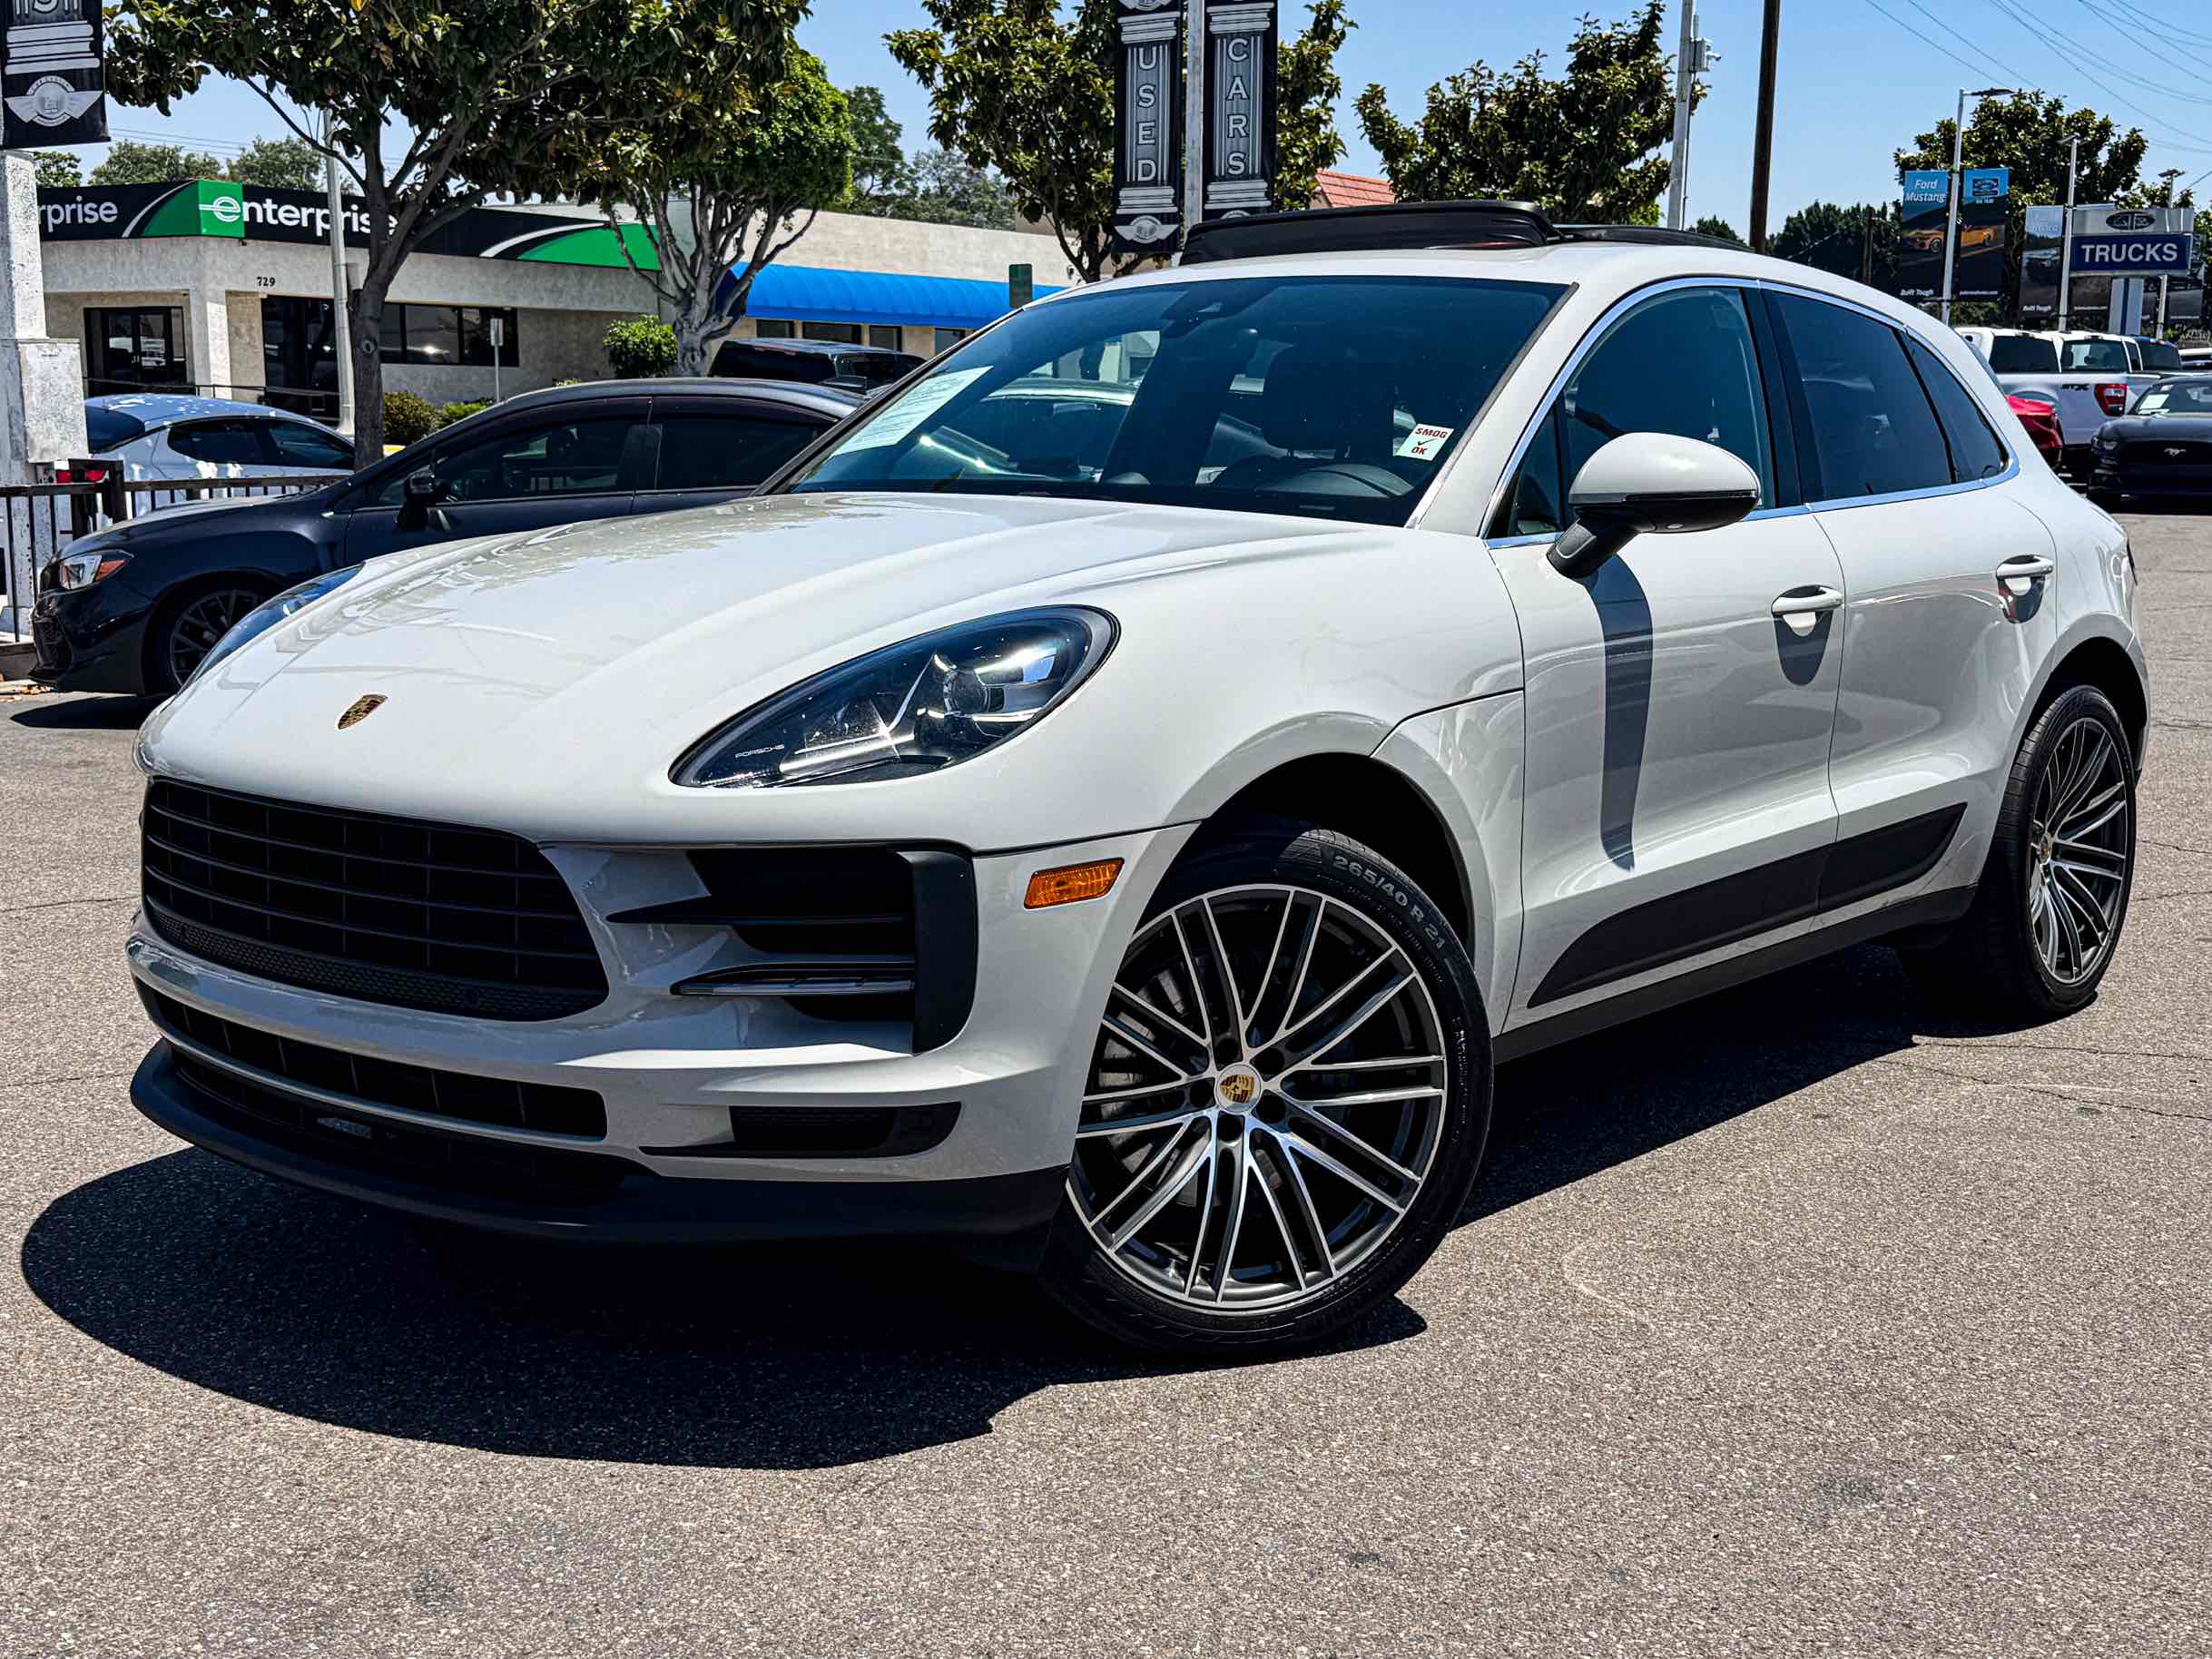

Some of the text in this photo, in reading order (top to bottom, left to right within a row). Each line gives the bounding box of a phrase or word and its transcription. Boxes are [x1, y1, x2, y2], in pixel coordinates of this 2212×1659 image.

[1226, 38, 1250, 175] CARS
[1137, 46, 1157, 182] USED
[1914, 179, 1939, 190] Ford
[1904, 191, 1947, 204] Mustang
[2080, 242, 2178, 262] TRUCKS
[256, 276, 276, 287] 729
[1415, 427, 1450, 438] SMOG
[1411, 446, 1429, 456] OK
[1333, 855, 1409, 907] 265/40
[1410, 905, 1424, 923] R
